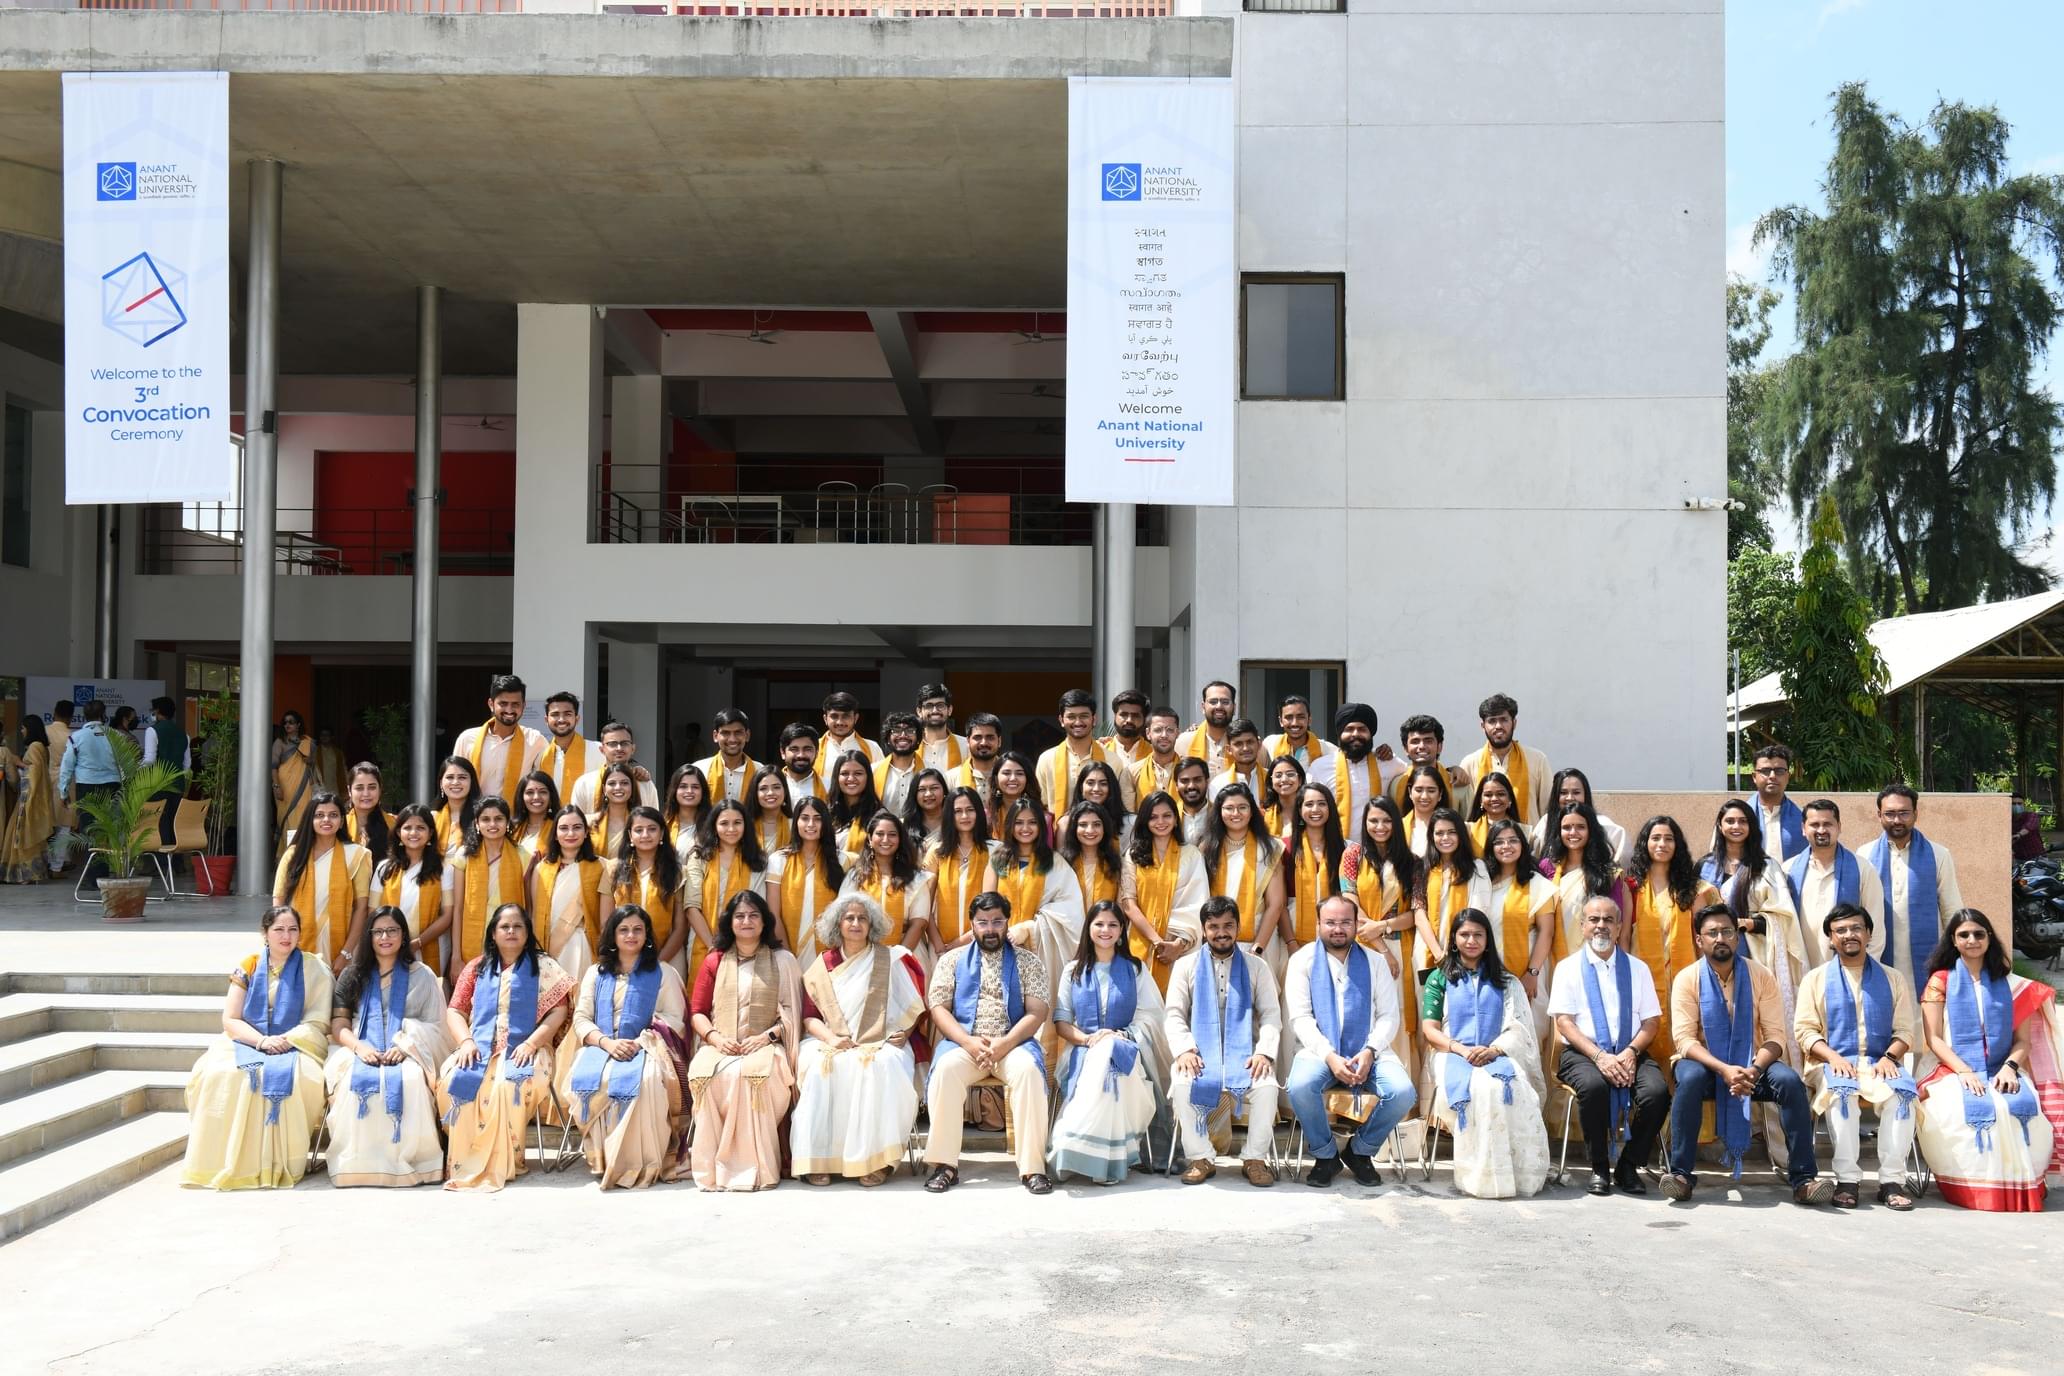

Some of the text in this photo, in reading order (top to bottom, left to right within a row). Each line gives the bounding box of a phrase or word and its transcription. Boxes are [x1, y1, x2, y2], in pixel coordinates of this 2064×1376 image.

[140, 165, 177, 174] ANANT
[1145, 167, 1183, 176] ANANT
[138, 174, 193, 184] NATIONAL
[1144, 176, 1198, 186] NATIONAL
[138, 184, 198, 194] UNIVERSITY
[1143, 187, 1202, 196] UNIVERSITY
[1138, 243, 1163, 252] स्वागत
[90, 365, 202, 380] Welcome to the
[134, 385, 159, 403] 3rd
[82, 403, 210, 423] Convocation
[1118, 403, 1183, 415] Welcome
[1097, 420, 1203, 432] Anant National
[110, 429, 184, 442] Ceremony
[1115, 437, 1185, 451] University
